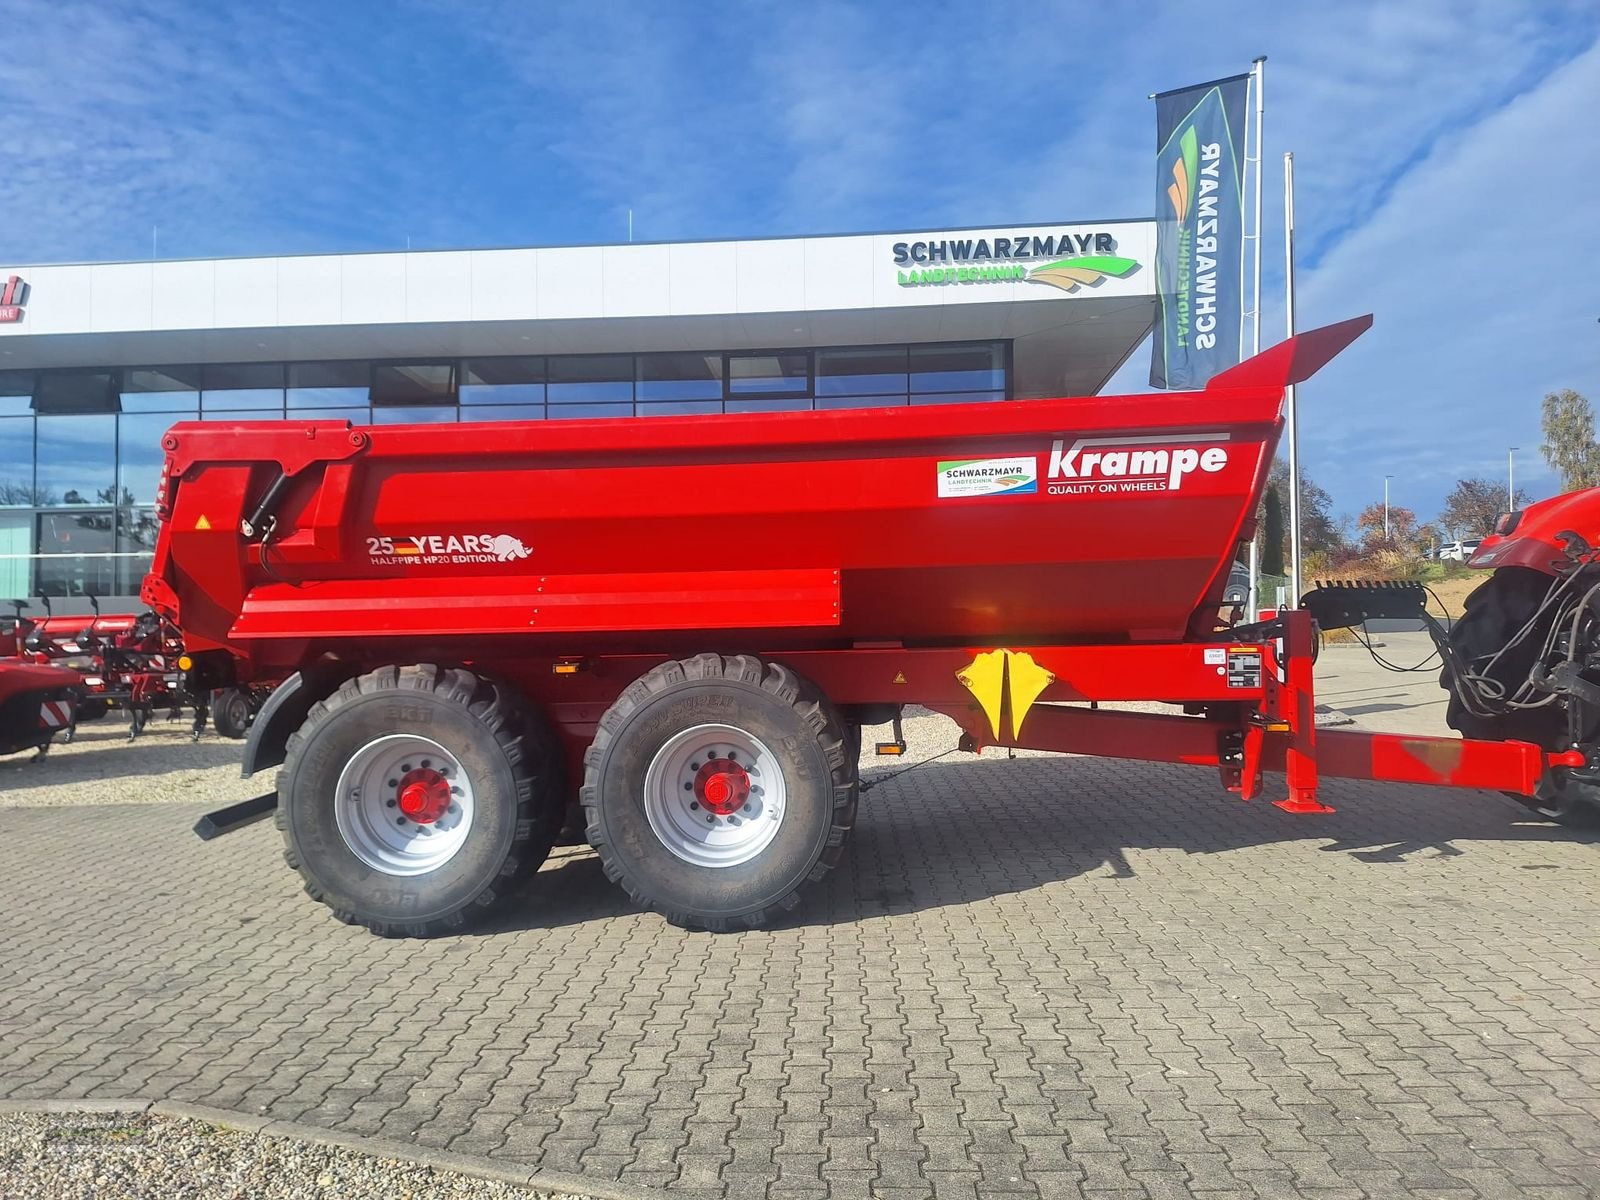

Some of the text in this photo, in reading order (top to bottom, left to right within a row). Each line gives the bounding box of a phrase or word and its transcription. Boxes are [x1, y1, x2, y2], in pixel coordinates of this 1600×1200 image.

[892, 232, 1113, 263] SCHWARZMAYR
[897, 264, 1024, 285] LANDTECHNIK
[946, 466, 1023, 479] SCHWARZMAYR
[1048, 439, 1228, 490] Krampe
[948, 478, 993, 486] LANDTECHNIK
[1047, 481, 1167, 496] QUALITY ON WHEELS
[366, 534, 494, 555] 25 YEARS
[370, 554, 497, 566] HALFPIPE HP20 EDITION
